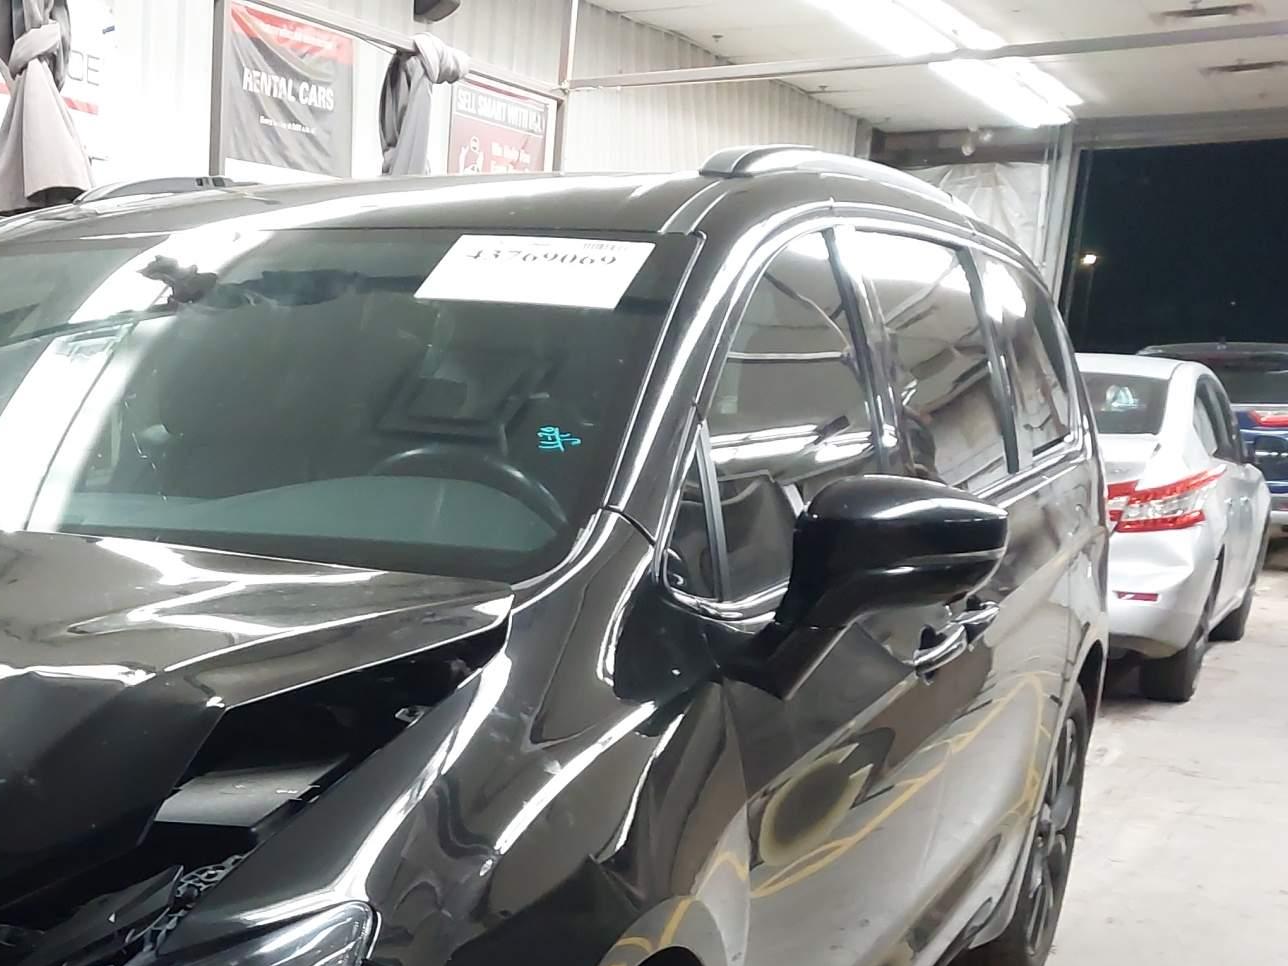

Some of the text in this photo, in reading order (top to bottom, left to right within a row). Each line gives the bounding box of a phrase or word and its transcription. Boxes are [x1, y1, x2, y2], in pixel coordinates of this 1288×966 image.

[241, 66, 334, 111] RENTAL CARS
[456, 88, 477, 114] SELL
[477, 94, 506, 122] SMART
